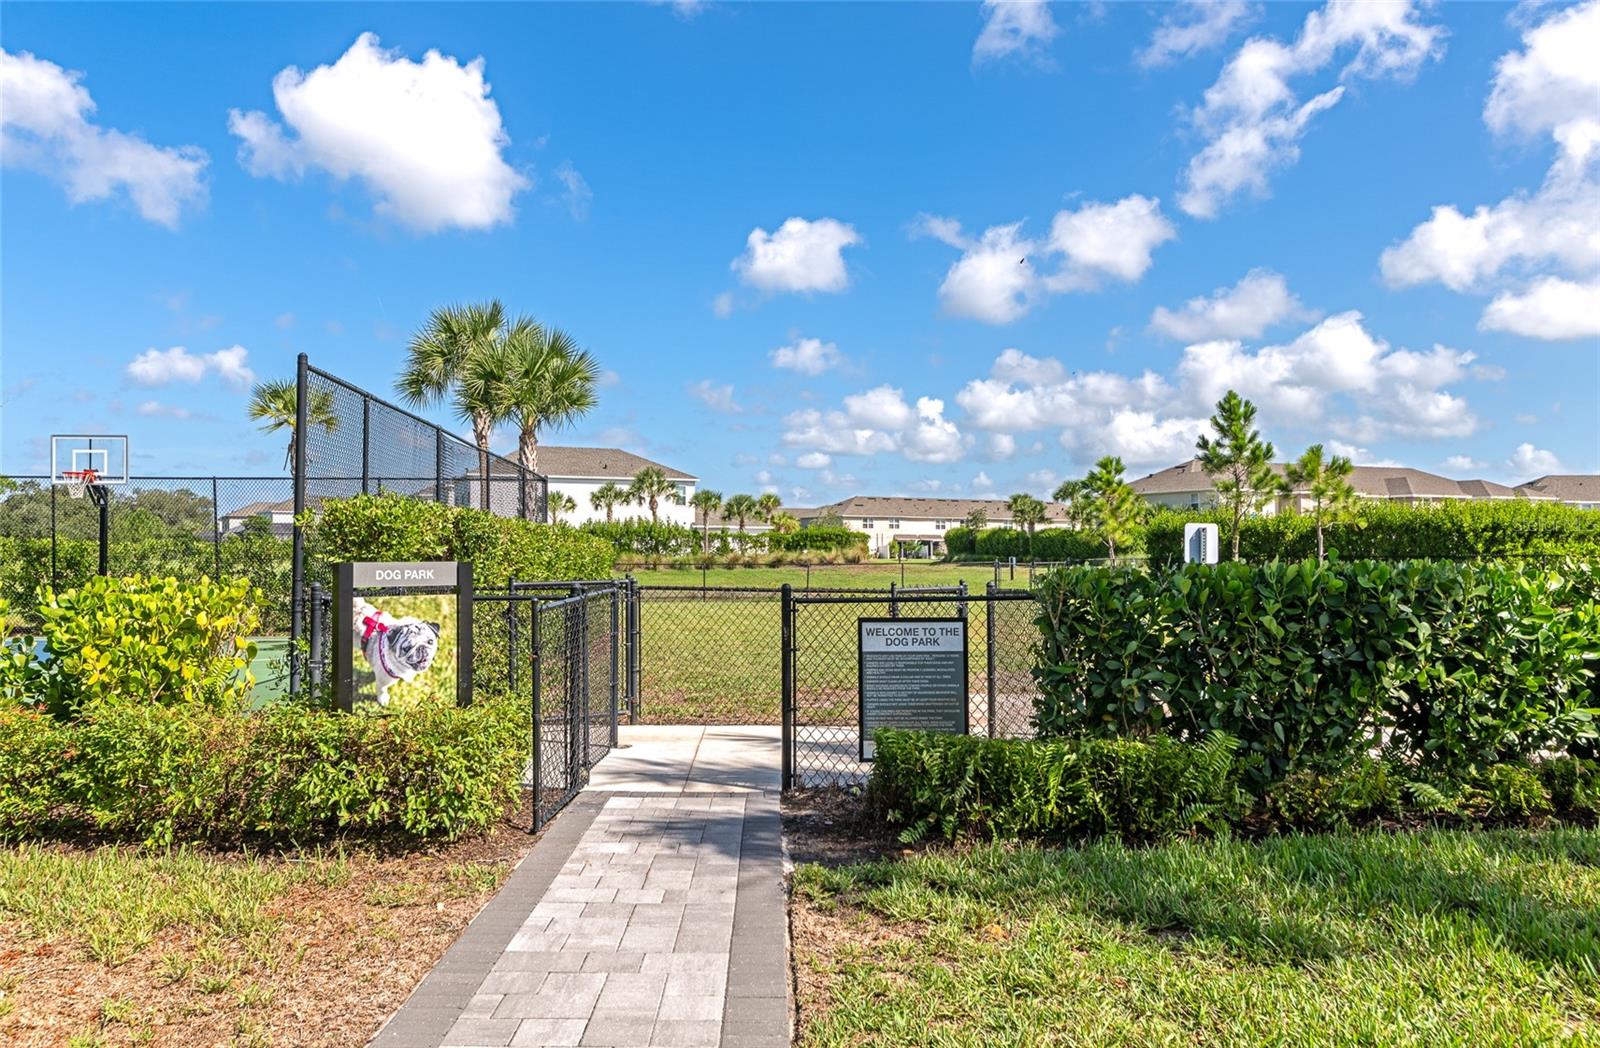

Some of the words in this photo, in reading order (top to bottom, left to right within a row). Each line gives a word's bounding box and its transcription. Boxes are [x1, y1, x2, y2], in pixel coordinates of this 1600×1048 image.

[375, 569, 402, 581] DOG
[404, 569, 435, 580] PARK
[865, 627, 919, 637] WELCOME
[922, 627, 937, 637] TO
[939, 627, 960, 637] THE
[885, 637, 909, 647] DOG
[911, 637, 940, 647] PARK
